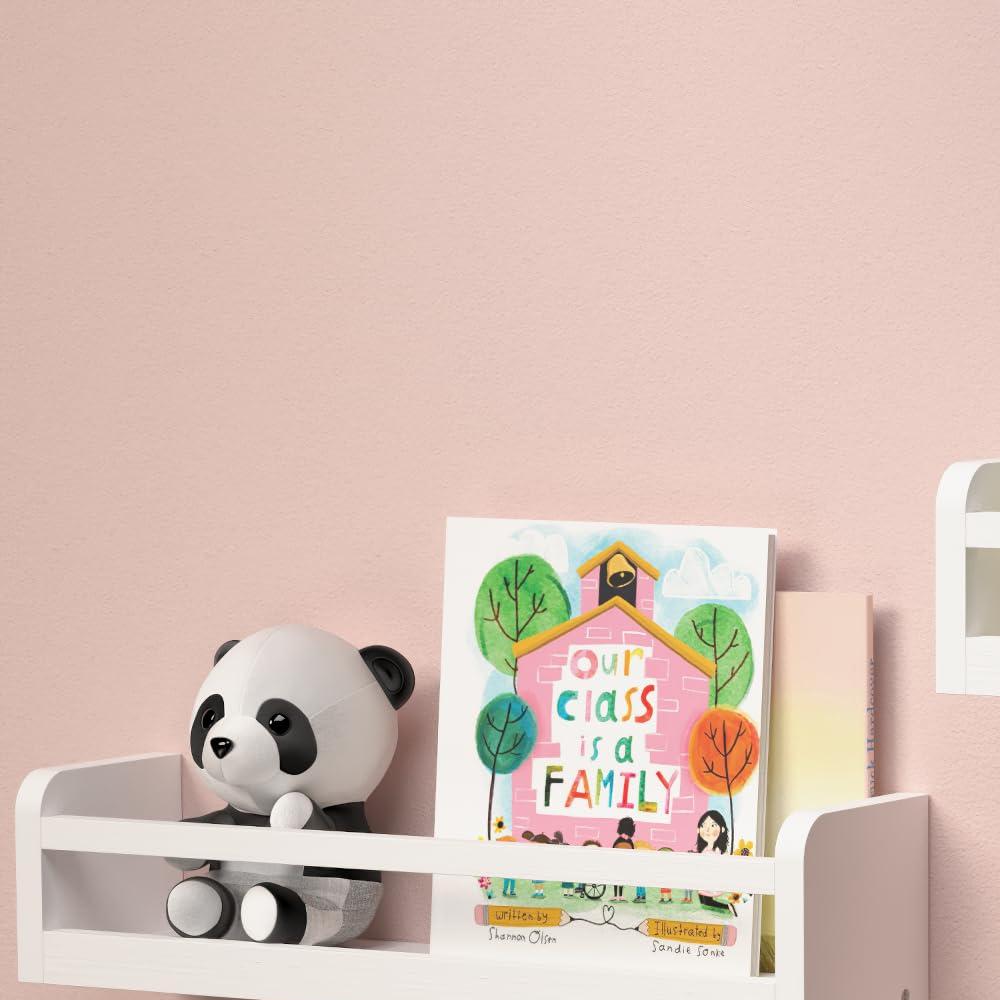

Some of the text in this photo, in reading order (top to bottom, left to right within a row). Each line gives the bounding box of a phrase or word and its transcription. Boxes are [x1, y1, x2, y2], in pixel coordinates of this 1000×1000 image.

[579, 735, 634, 764] is a
[543, 765, 681, 815] FAMILY
[537, 910, 548, 924] by
[489, 926, 557, 944] Shannon Olsen
[654, 920, 708, 938] Illustrated
[652, 939, 692, 955] Sandie
